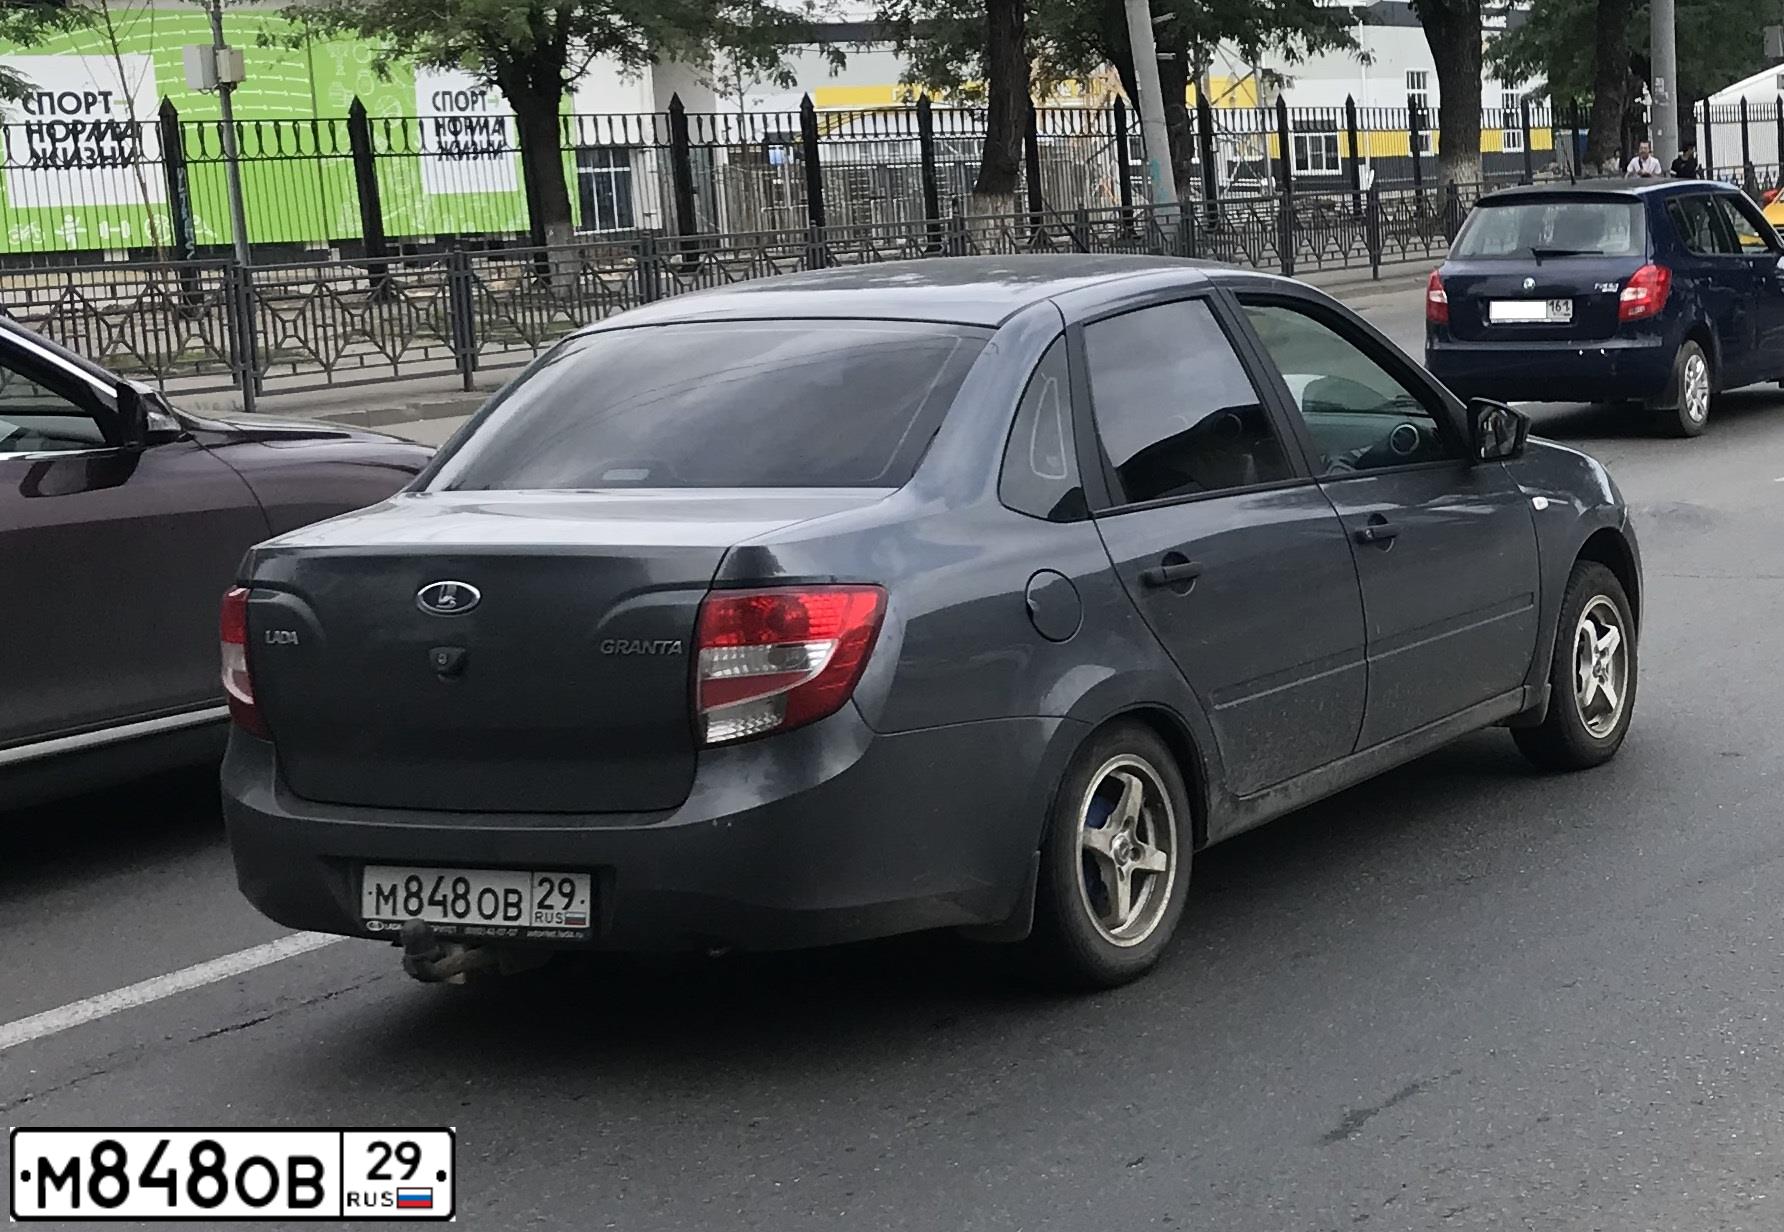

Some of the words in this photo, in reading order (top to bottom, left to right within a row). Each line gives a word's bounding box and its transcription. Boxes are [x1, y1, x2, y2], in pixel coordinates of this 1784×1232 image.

[22, 91, 113, 115] СПОРТ
[432, 90, 487, 112] СПОРТ
[26, 119, 139, 143] НОРМА
[1549, 300, 1570, 312] 161
[265, 630, 299, 645] LADA
[600, 639, 682, 655] GRANTA
[537, 877, 576, 911] 29
[534, 911, 564, 925] RUS
